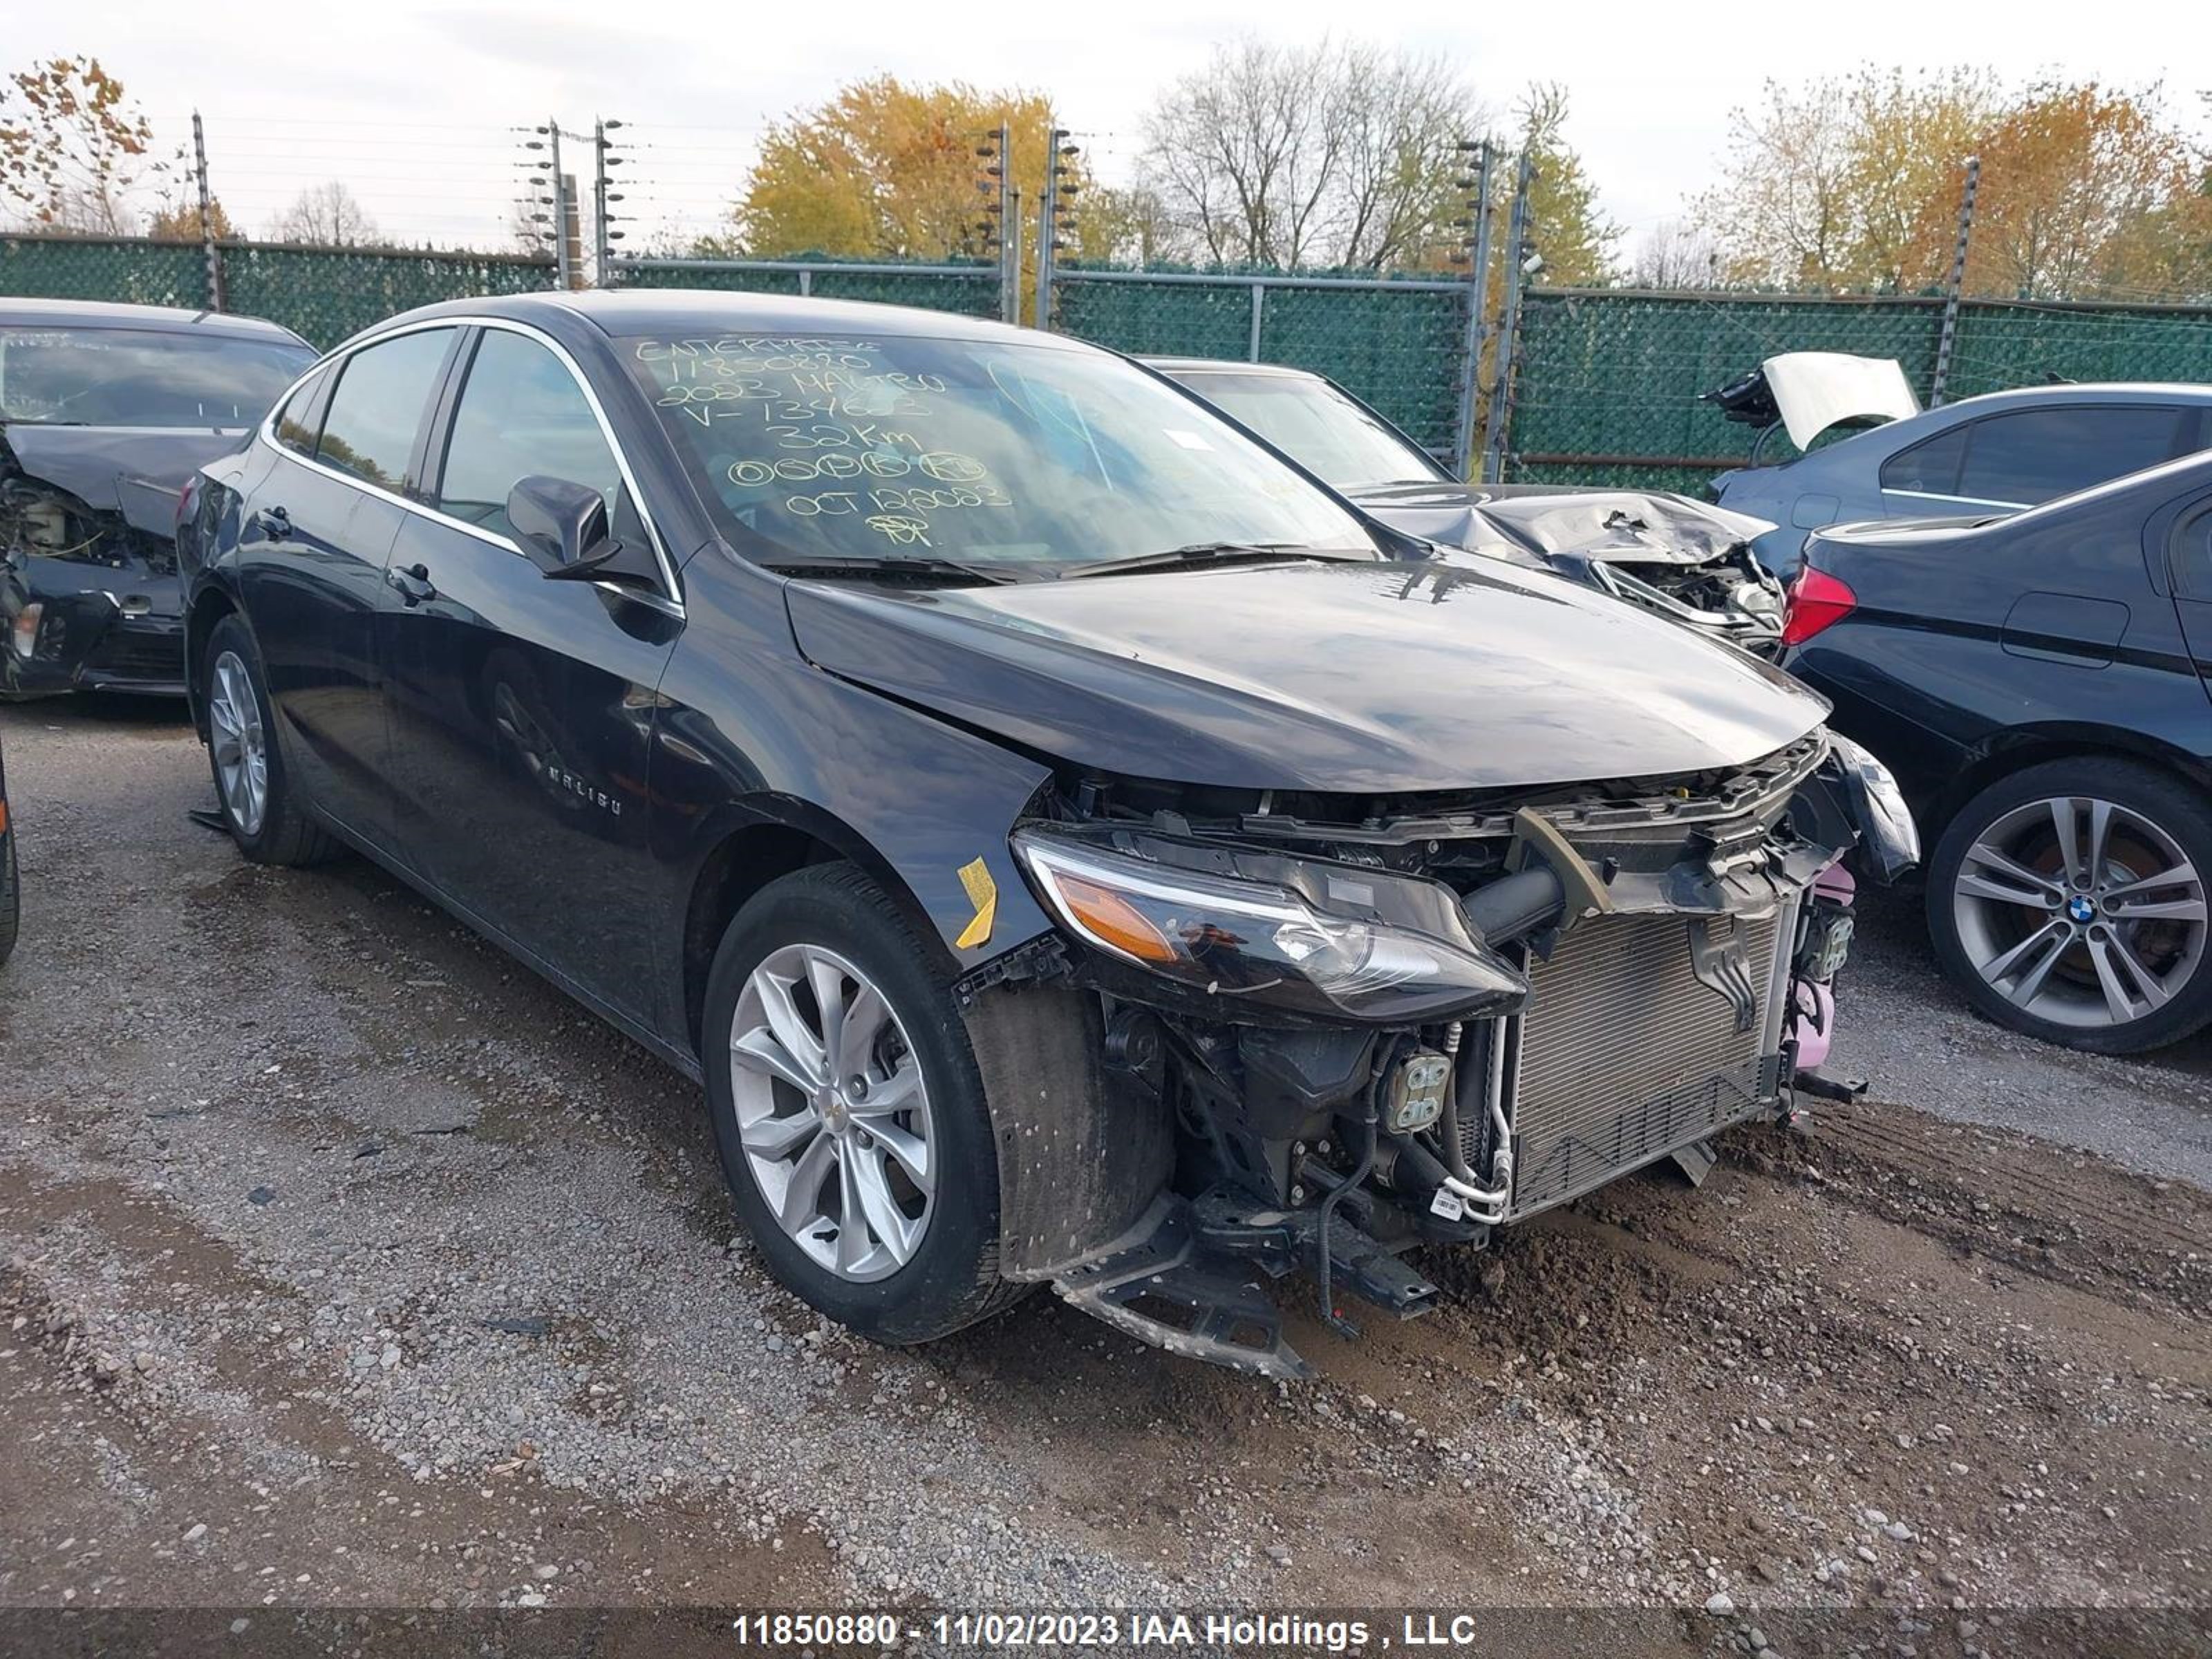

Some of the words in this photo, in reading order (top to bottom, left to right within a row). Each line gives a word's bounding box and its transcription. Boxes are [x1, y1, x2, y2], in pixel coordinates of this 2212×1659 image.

[656, 379, 782, 406] 2023
[786, 492, 859, 516] OCT
[549, 766, 621, 816] MALIBU
